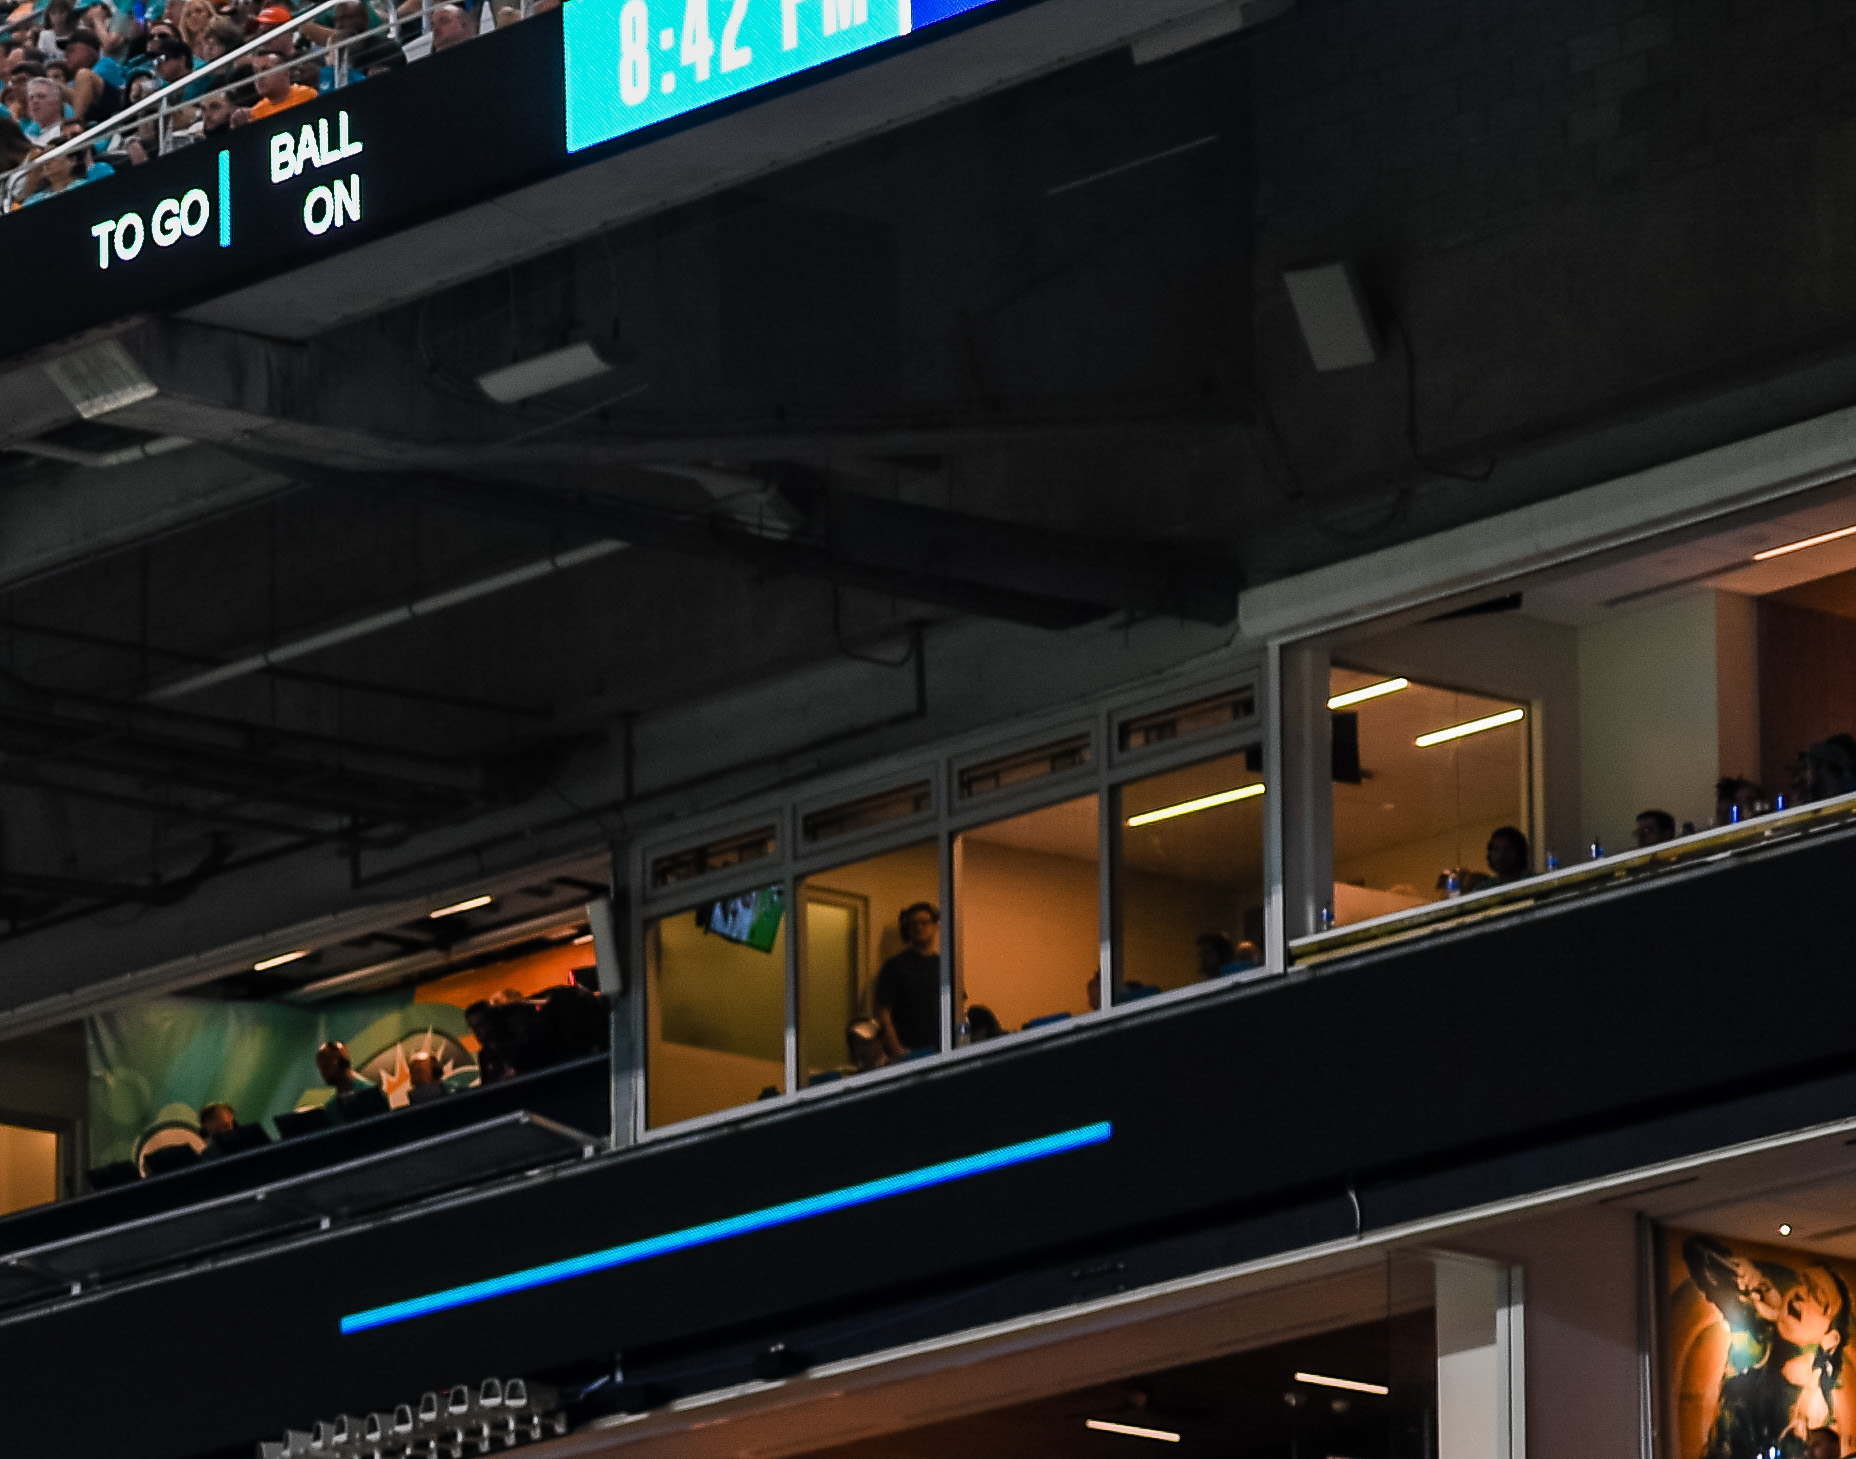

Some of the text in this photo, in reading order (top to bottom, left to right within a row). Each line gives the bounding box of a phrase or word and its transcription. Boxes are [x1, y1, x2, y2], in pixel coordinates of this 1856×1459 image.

[270, 109, 364, 184] BALL
[92, 188, 210, 270] TO GO
[303, 172, 361, 236] ON
